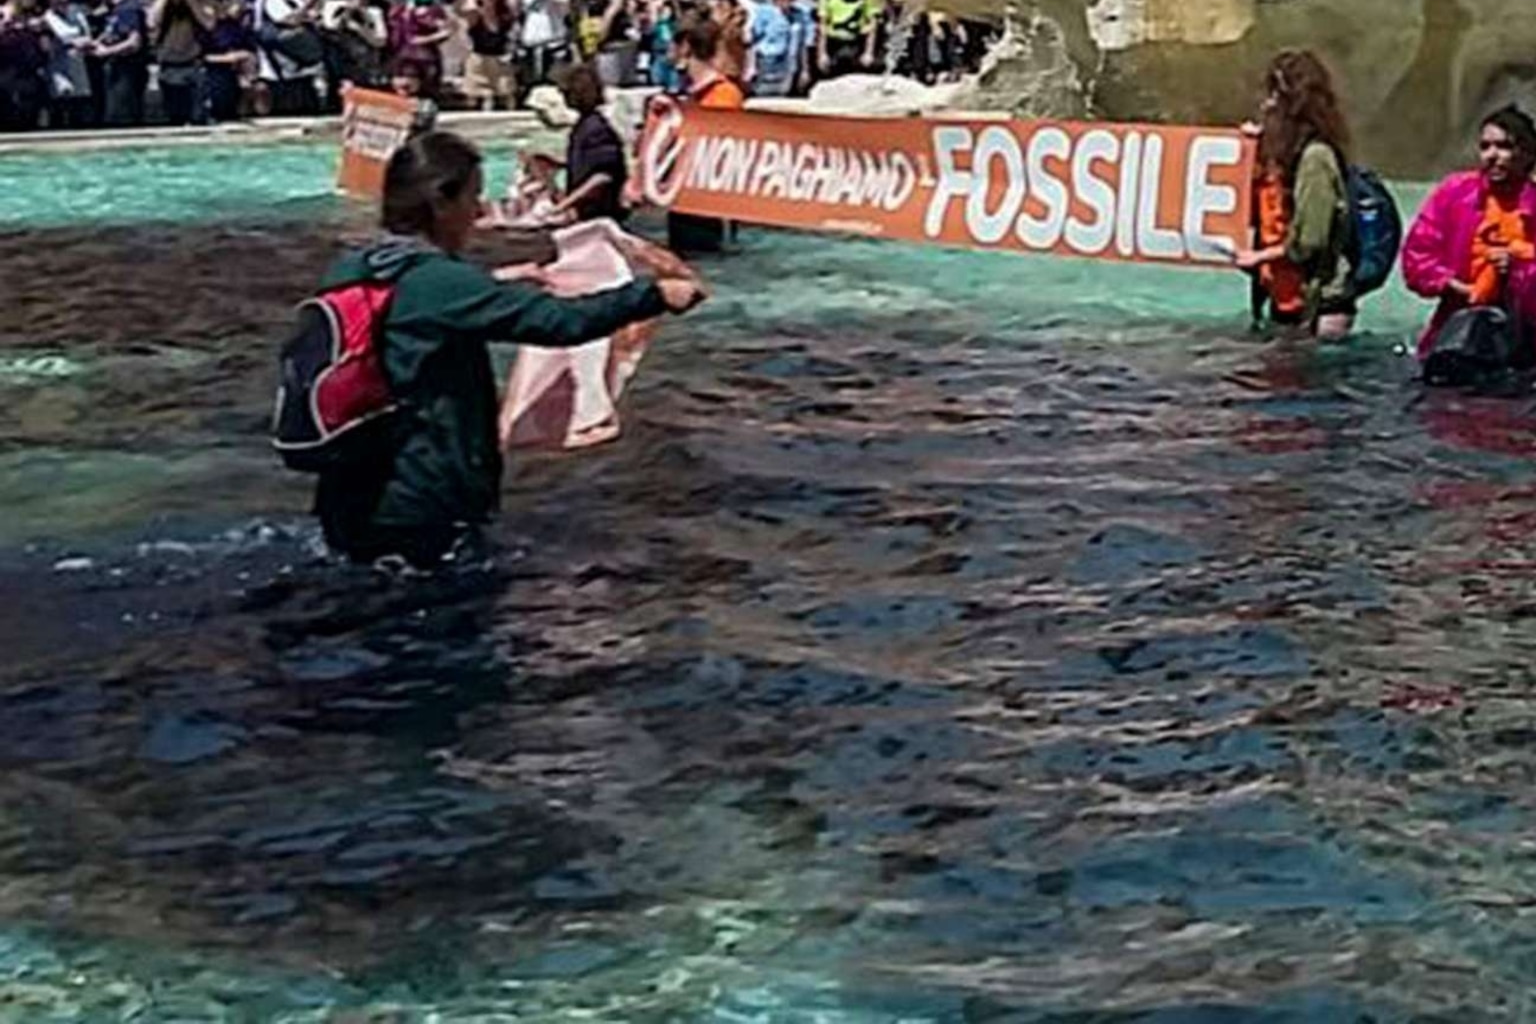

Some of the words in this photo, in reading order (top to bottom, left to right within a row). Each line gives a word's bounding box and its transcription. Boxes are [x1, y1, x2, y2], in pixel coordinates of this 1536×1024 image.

[686, 135, 752, 194] NON
[750, 140, 914, 212] PAGHIAMO
[925, 126, 1241, 262] FOSSILE
